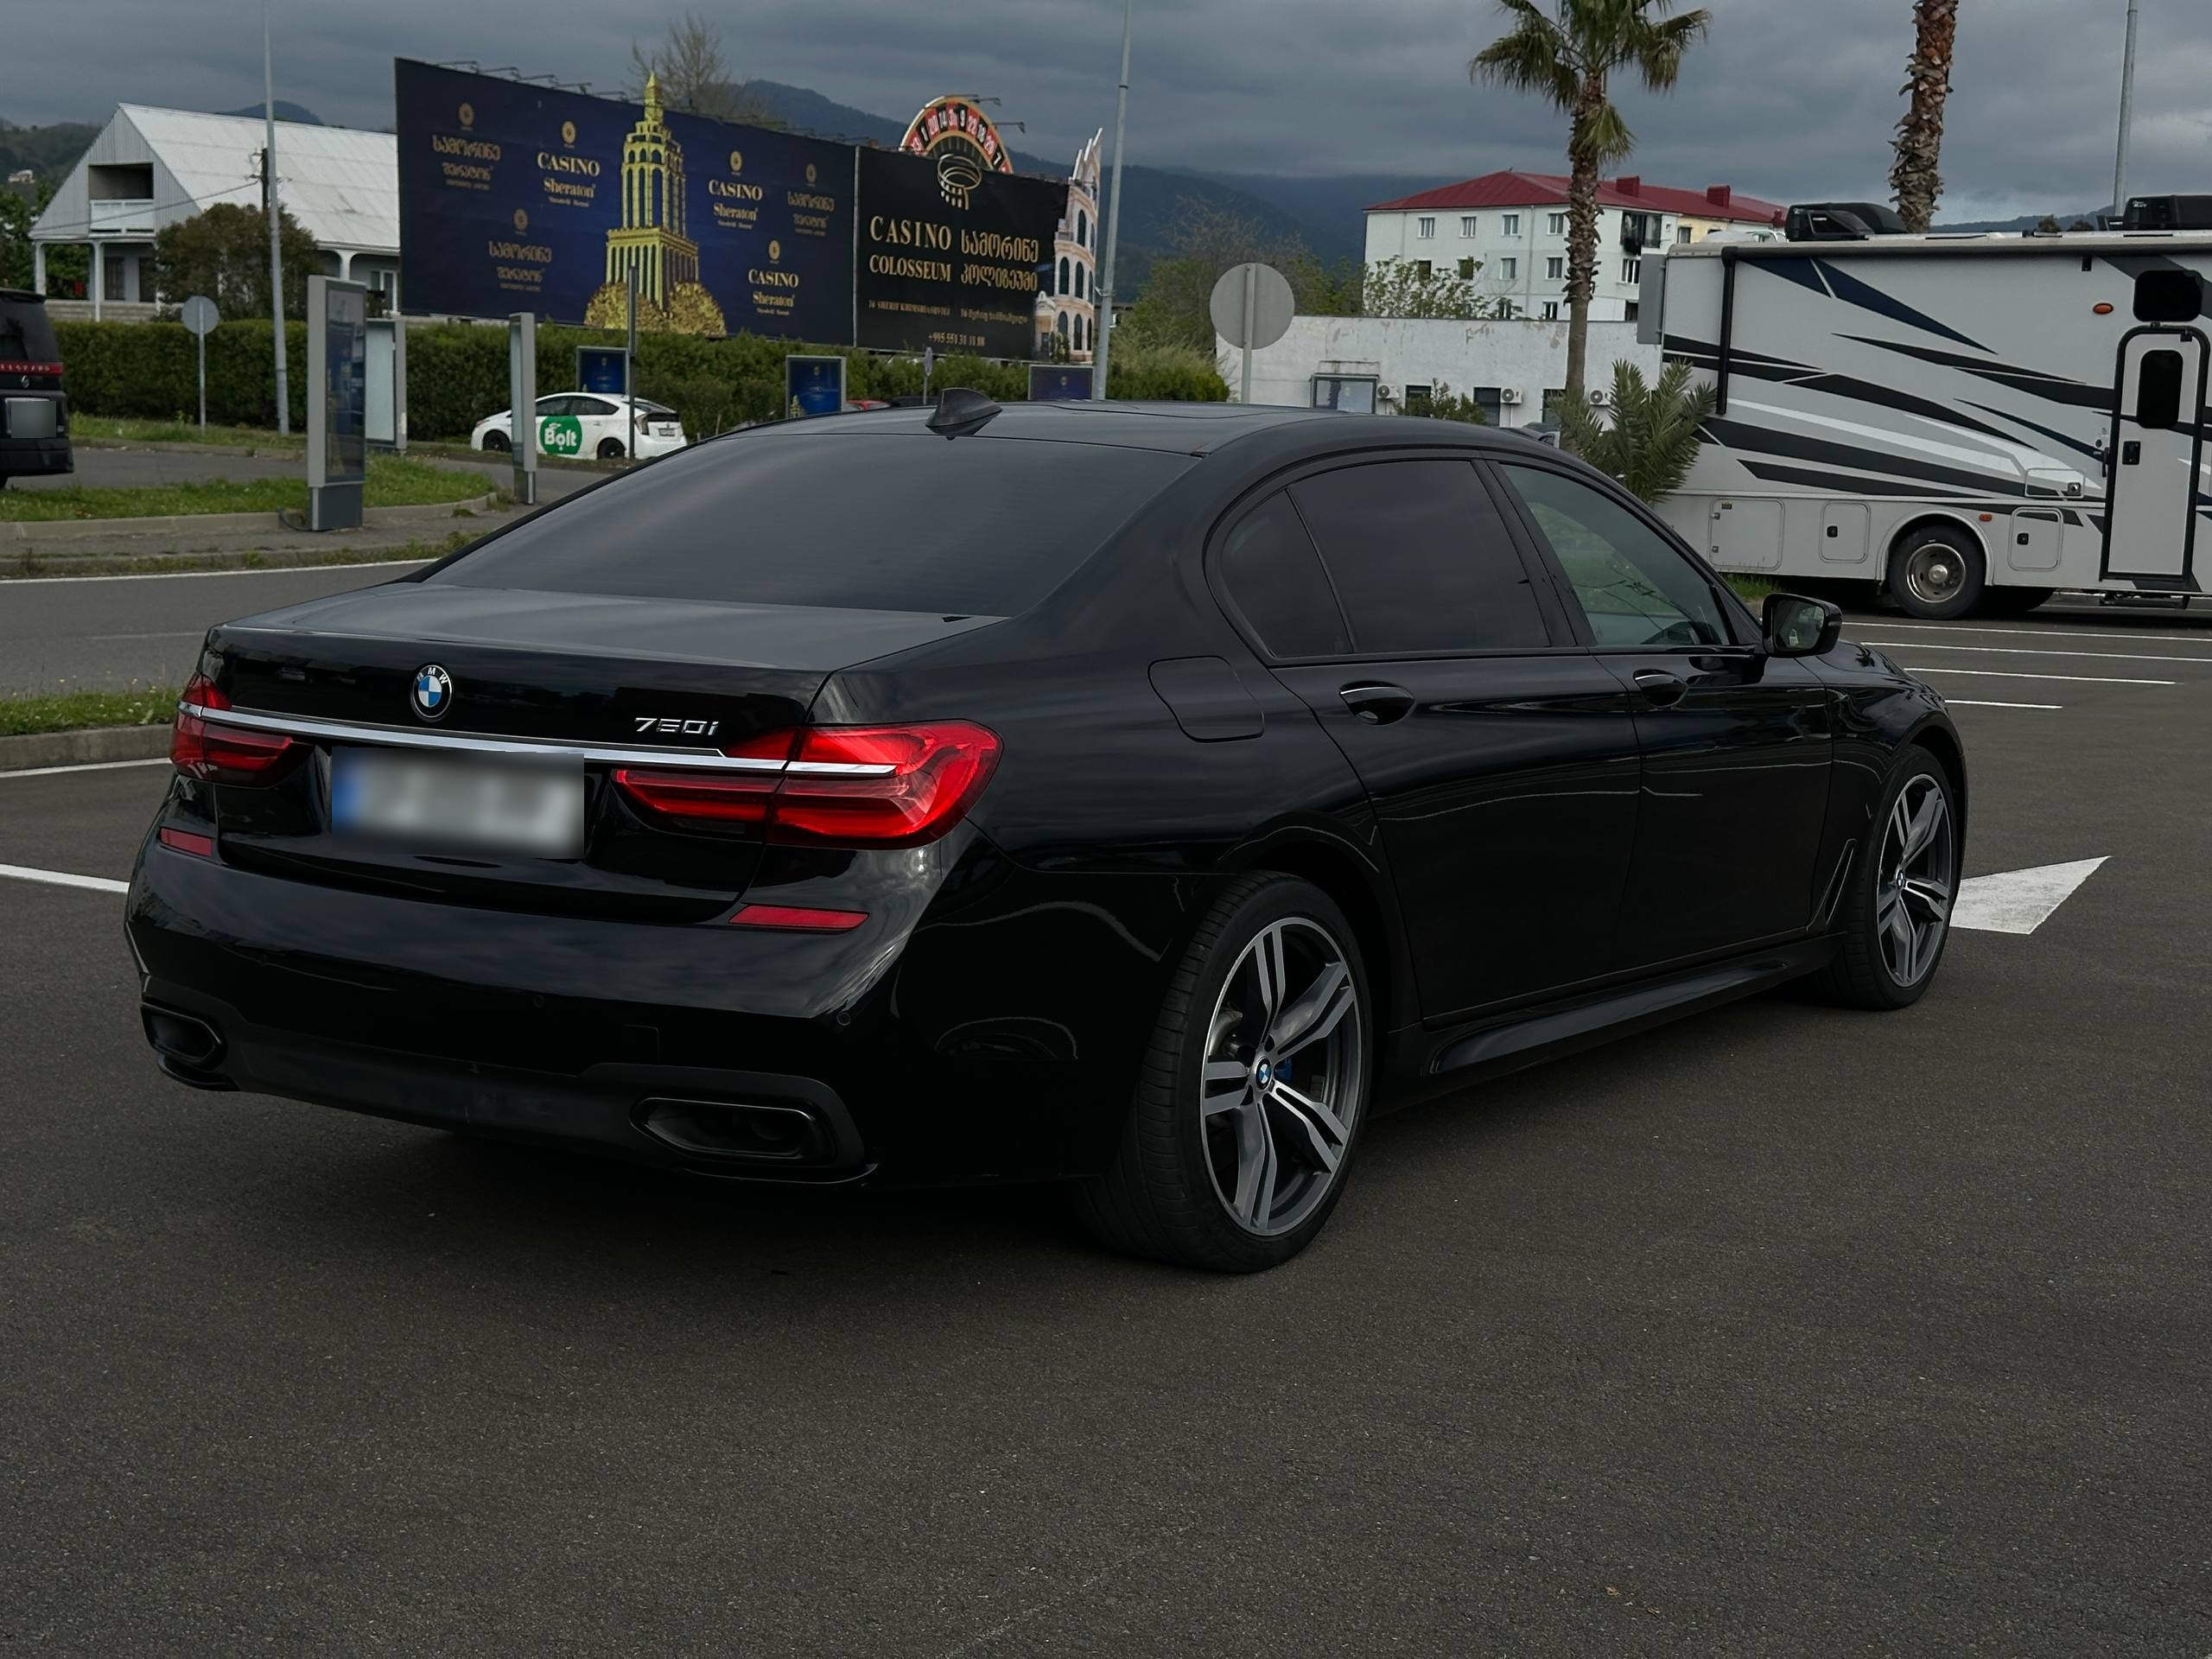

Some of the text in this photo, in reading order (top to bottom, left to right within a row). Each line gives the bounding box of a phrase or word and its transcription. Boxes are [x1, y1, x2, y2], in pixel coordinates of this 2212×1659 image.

[537, 151, 601, 176] CASINO
[543, 176, 596, 199] Sheraton
[709, 179, 763, 200] CASINO
[714, 202, 759, 221] Sheraton
[869, 215, 952, 251] CASINO
[960, 228, 1039, 263] სამორინე
[748, 268, 799, 289] CASINO
[869, 254, 951, 282] COLOSSEUM
[753, 290, 795, 308] Sheraton
[544, 427, 576, 447] Bolt
[416, 666, 449, 684] BMW
[635, 716, 719, 735] 750i
